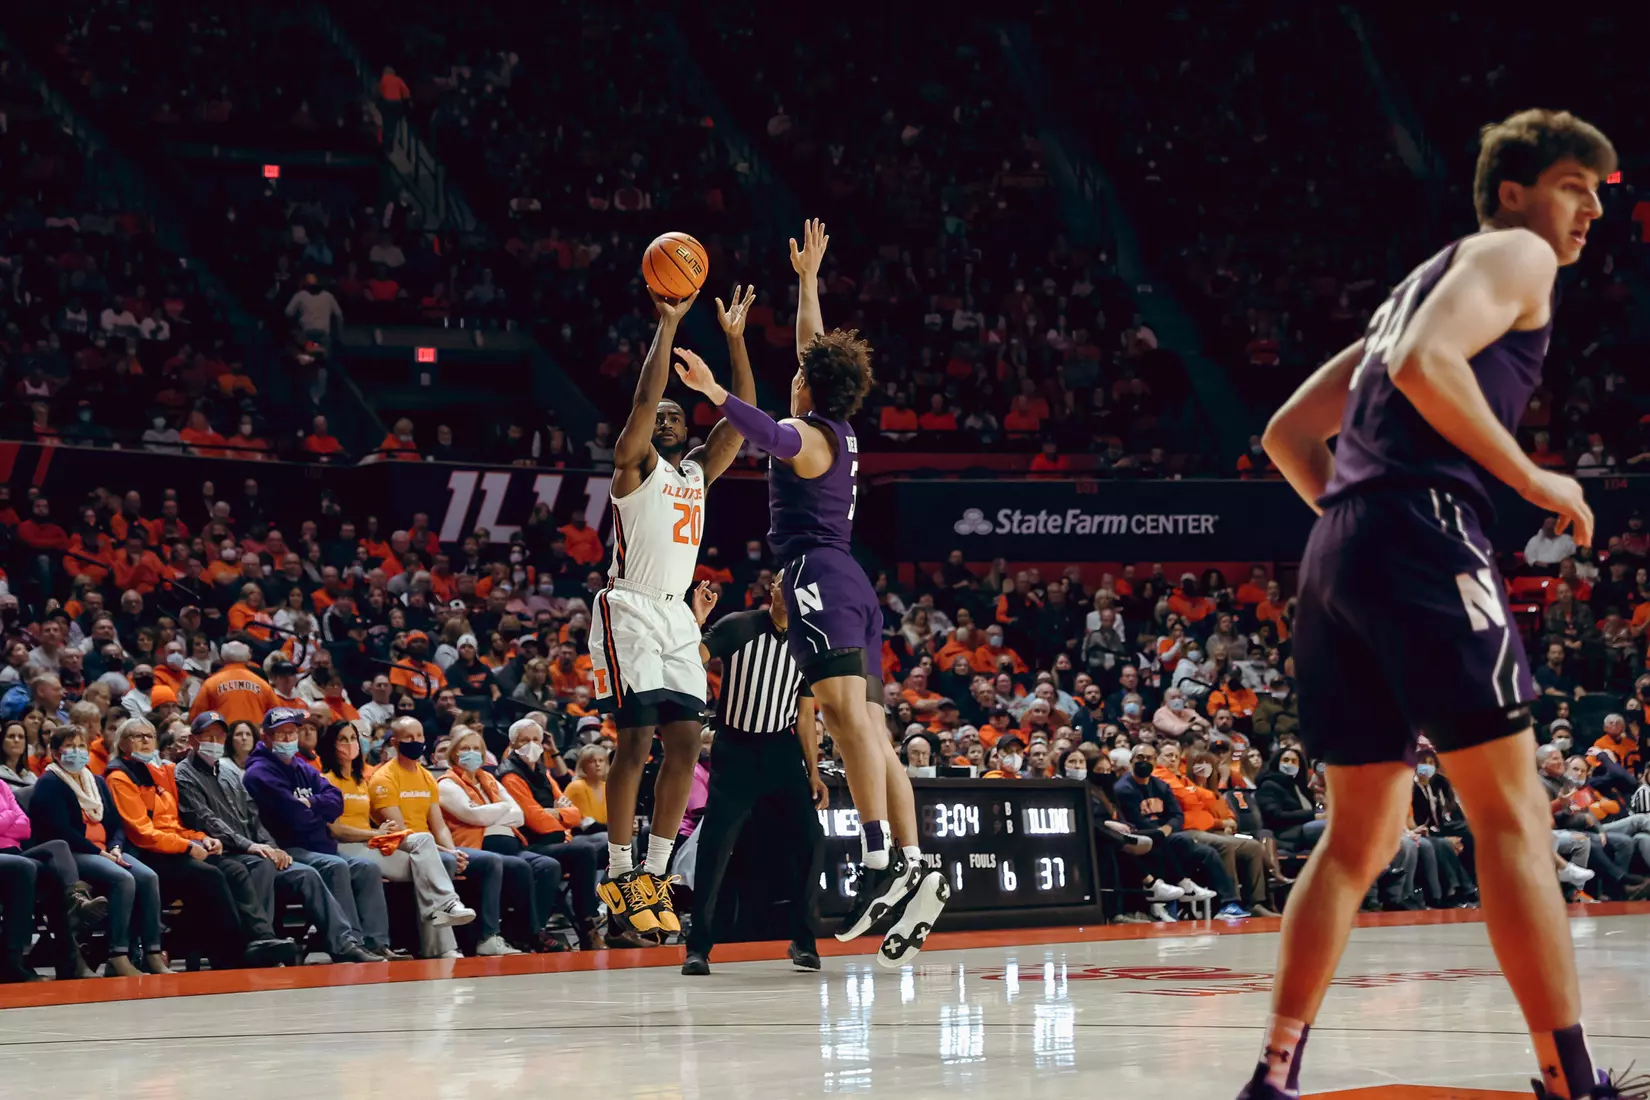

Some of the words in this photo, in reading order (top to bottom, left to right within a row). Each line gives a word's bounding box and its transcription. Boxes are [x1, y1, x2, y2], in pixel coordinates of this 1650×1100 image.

[675, 245, 703, 277] ELITE
[672, 502, 701, 546] 20
[1130, 514, 1215, 535] CENTER
[794, 582, 824, 617] N
[1455, 567, 1507, 632] N
[217, 680, 261, 694] ILLINOIS
[935, 803, 980, 837] 3:04
[1027, 807, 1070, 834] ILLINI
[968, 853, 997, 869] FOULS
[1002, 860, 1018, 892] 6
[1039, 857, 1066, 891] 37
